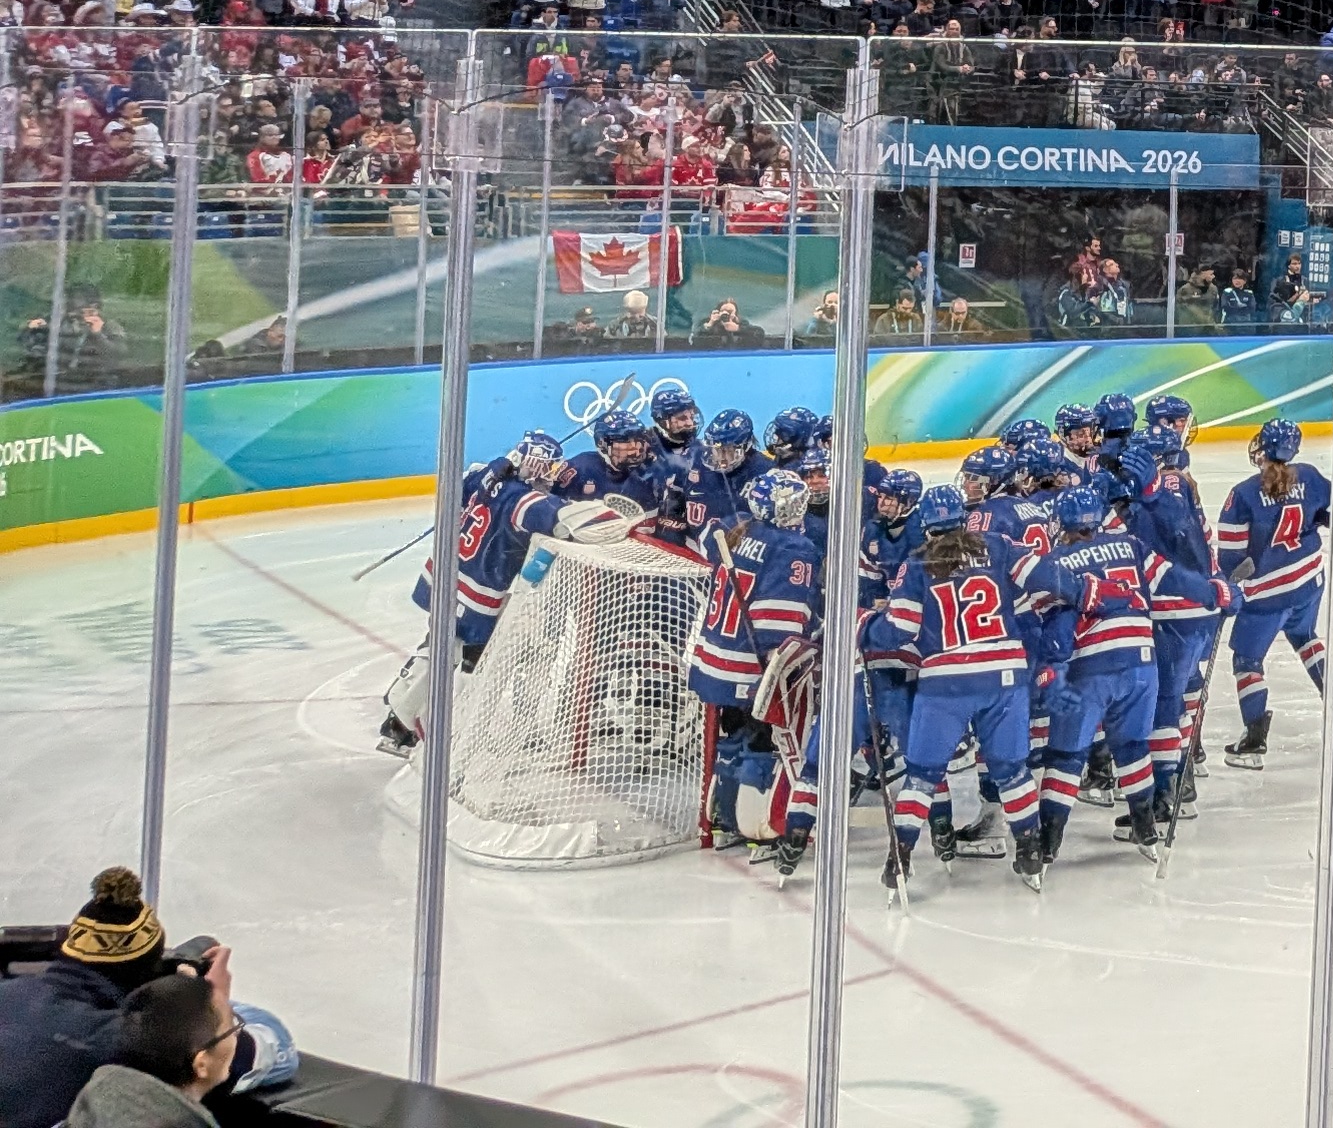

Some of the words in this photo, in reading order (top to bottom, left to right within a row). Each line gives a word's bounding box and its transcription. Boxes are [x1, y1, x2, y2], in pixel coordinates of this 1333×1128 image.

[876, 142, 992, 171] MILANO
[997, 145, 1136, 174] CORTINA
[1141, 149, 1202, 175] 2026
[967, 512, 993, 532] 21
[1271, 504, 1304, 553] 4
[1054, 541, 1135, 570] ARPENTER
[788, 560, 814, 588] 31
[930, 575, 1008, 652] 12
